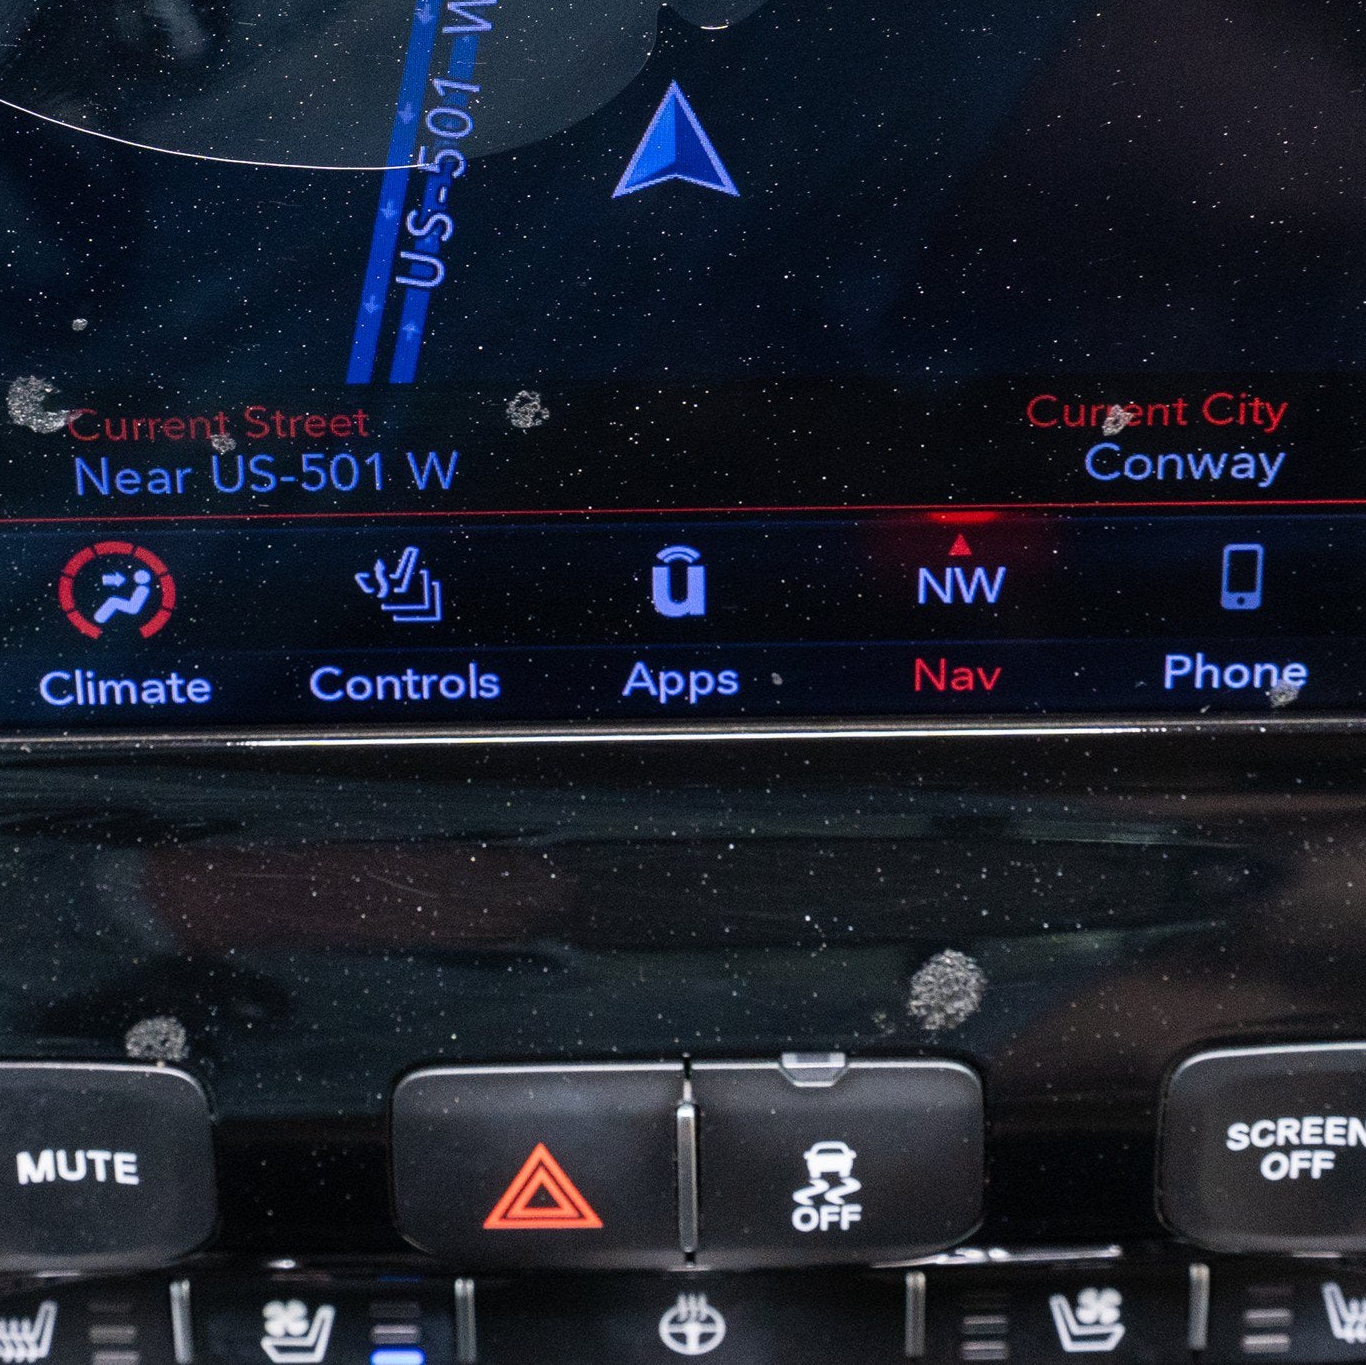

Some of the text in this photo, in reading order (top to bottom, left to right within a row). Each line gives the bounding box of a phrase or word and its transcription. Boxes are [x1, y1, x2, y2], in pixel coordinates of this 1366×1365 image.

[395, 77, 482, 289] US-501
[67, 405, 370, 441] Current Street
[1202, 391, 1289, 433] City
[75, 449, 459, 496] Near US-501 W
[1085, 442, 1286, 487] Conway
[918, 566, 1007, 605] NW
[39, 669, 213, 707] Climate
[310, 662, 501, 701] Controls
[621, 661, 740, 704] Apps
[914, 657, 1002, 693] Nav
[1164, 652, 1309, 689] Phone
[16, 1149, 139, 1185] MUTE
[1260, 1149, 1336, 1181] OFF
[791, 1203, 863, 1233] OFF
